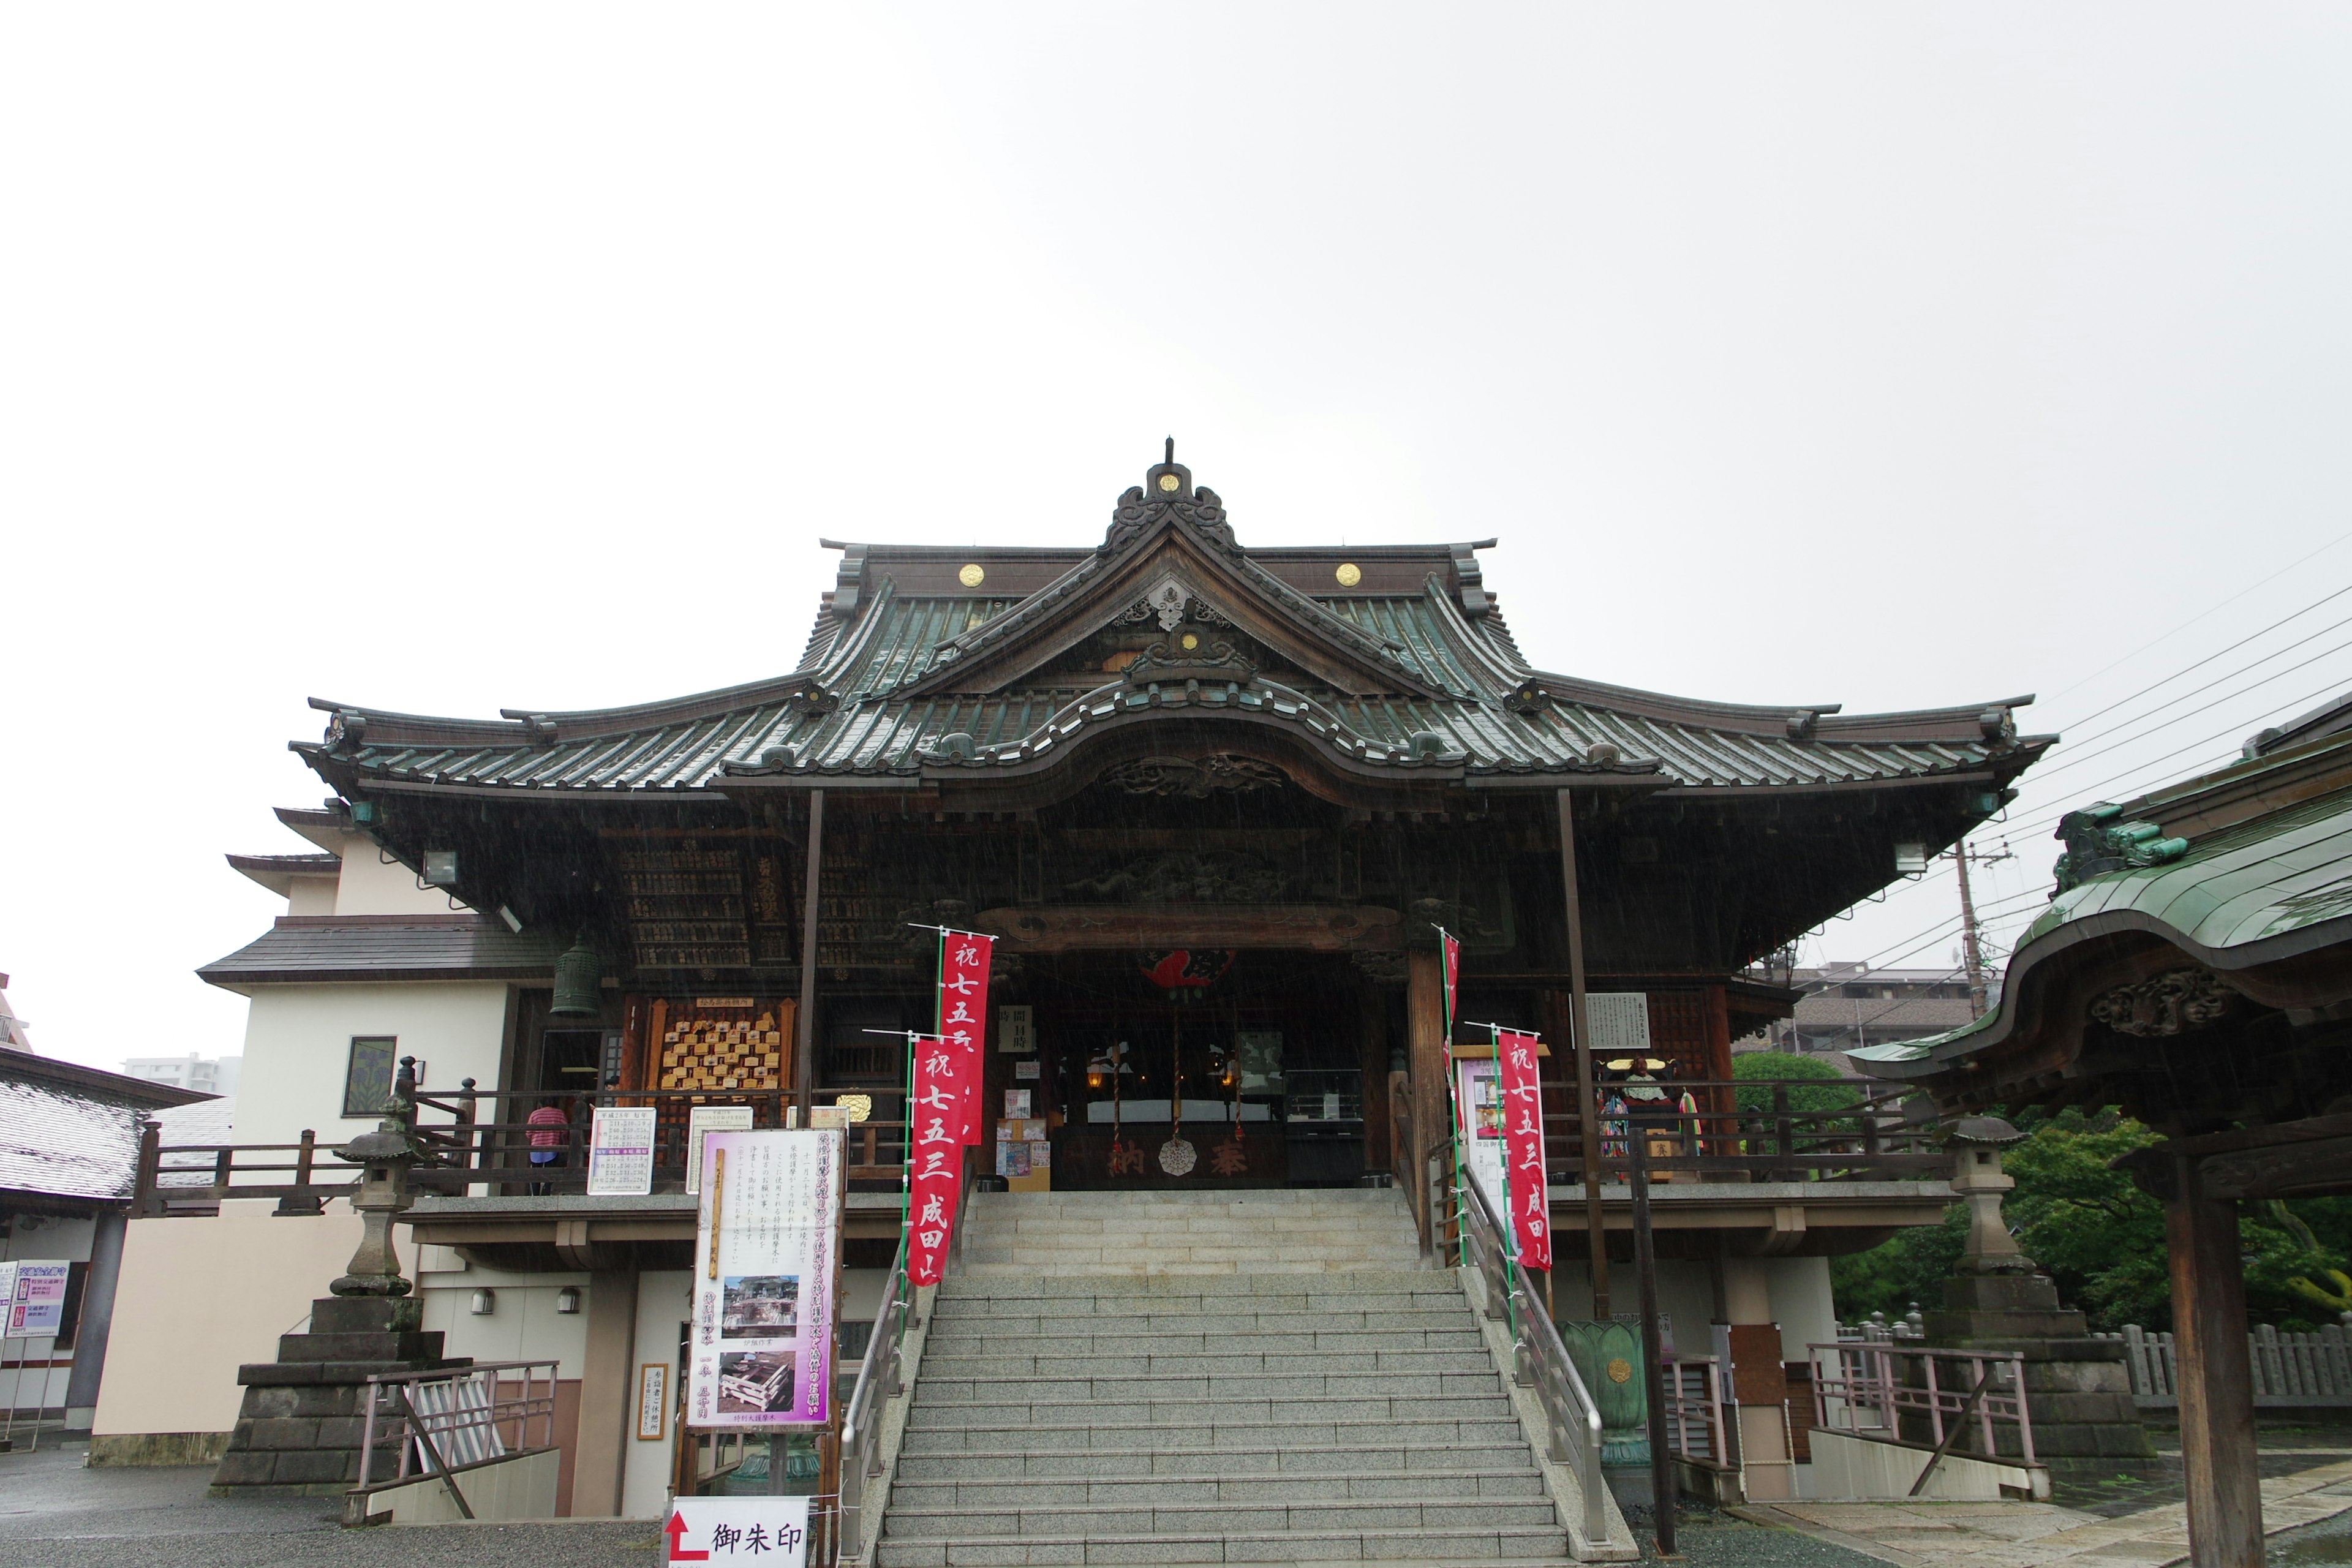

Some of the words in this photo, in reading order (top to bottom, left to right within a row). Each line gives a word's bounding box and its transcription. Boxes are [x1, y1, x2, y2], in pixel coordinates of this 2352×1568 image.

[918, 1050, 956, 1180] 祝七五三
[919, 1194, 948, 1279] 成田山
[19, 1267, 66, 1276] 交通安全御守
[710, 1523, 802, 1555] 御朱印
